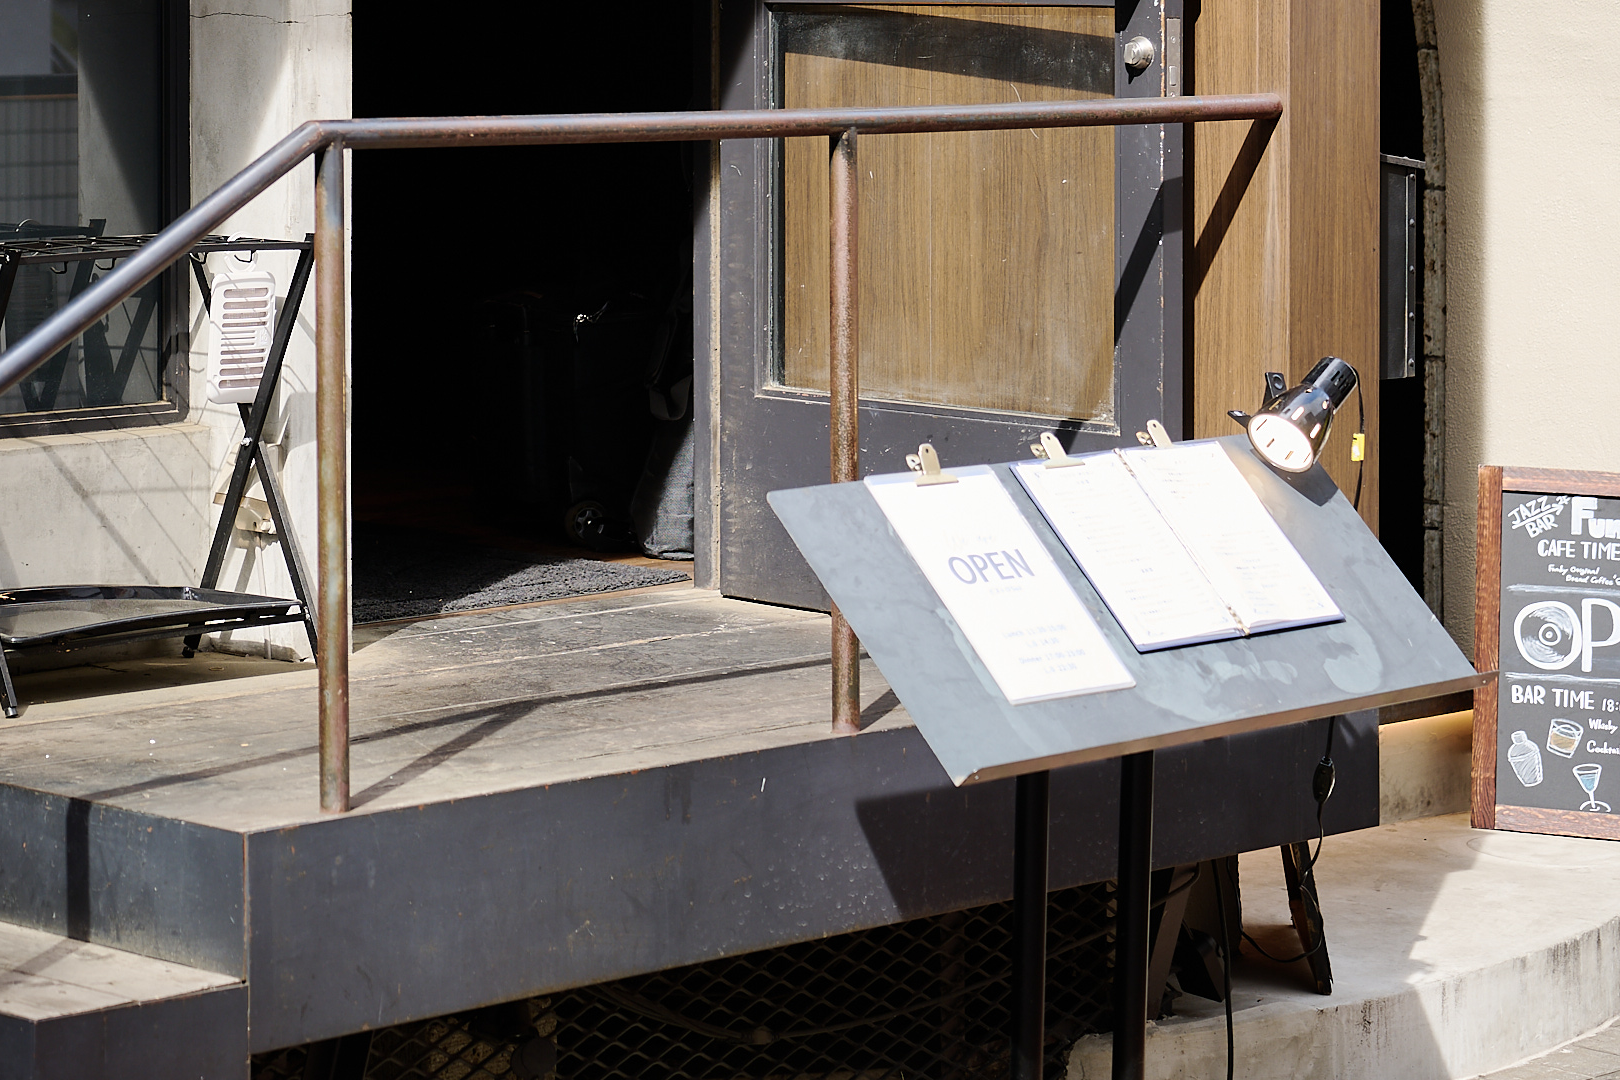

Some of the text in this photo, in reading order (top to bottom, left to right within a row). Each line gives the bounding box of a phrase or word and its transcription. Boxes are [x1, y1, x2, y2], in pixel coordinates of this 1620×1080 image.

[1507, 495, 1552, 525] JAZZ
[1524, 514, 1559, 539] BAR
[1537, 538, 1620, 561] CAFE TIME
[947, 548, 1036, 585] OPEN
[1511, 684, 1620, 713] BAR TIME 18:
[1588, 718, 1619, 735] Whisky
